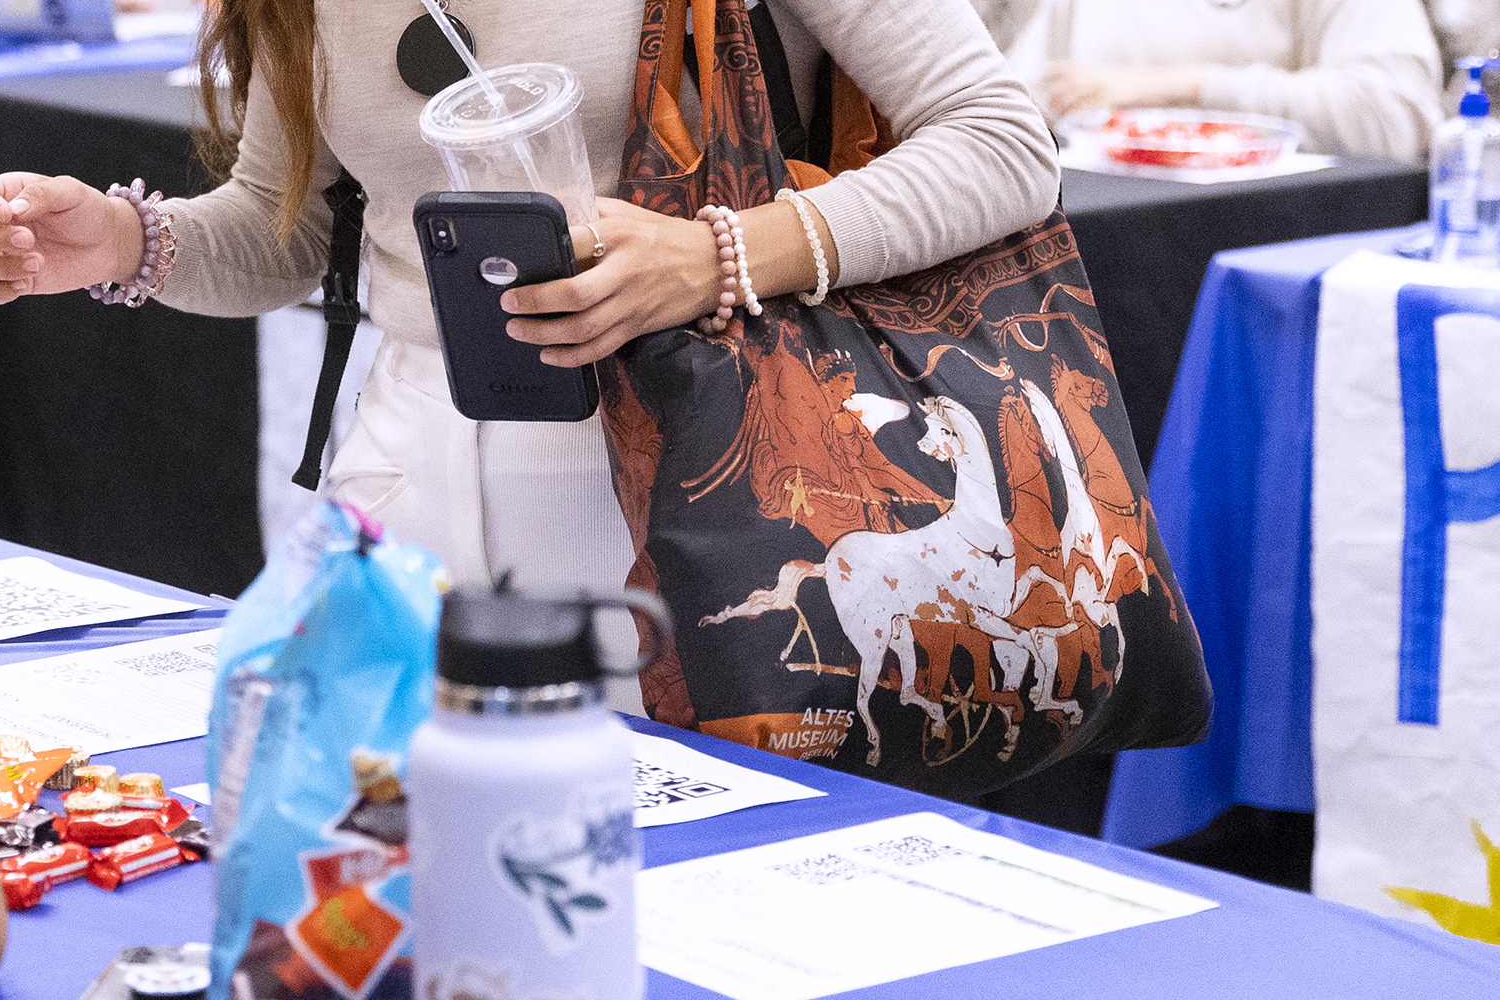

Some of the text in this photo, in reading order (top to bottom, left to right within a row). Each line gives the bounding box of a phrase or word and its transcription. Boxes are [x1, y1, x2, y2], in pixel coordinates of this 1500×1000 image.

[800, 707, 856, 728] ALTES
[767, 728, 849, 750] MUSEUM
[800, 749, 839, 761] BERLIN
